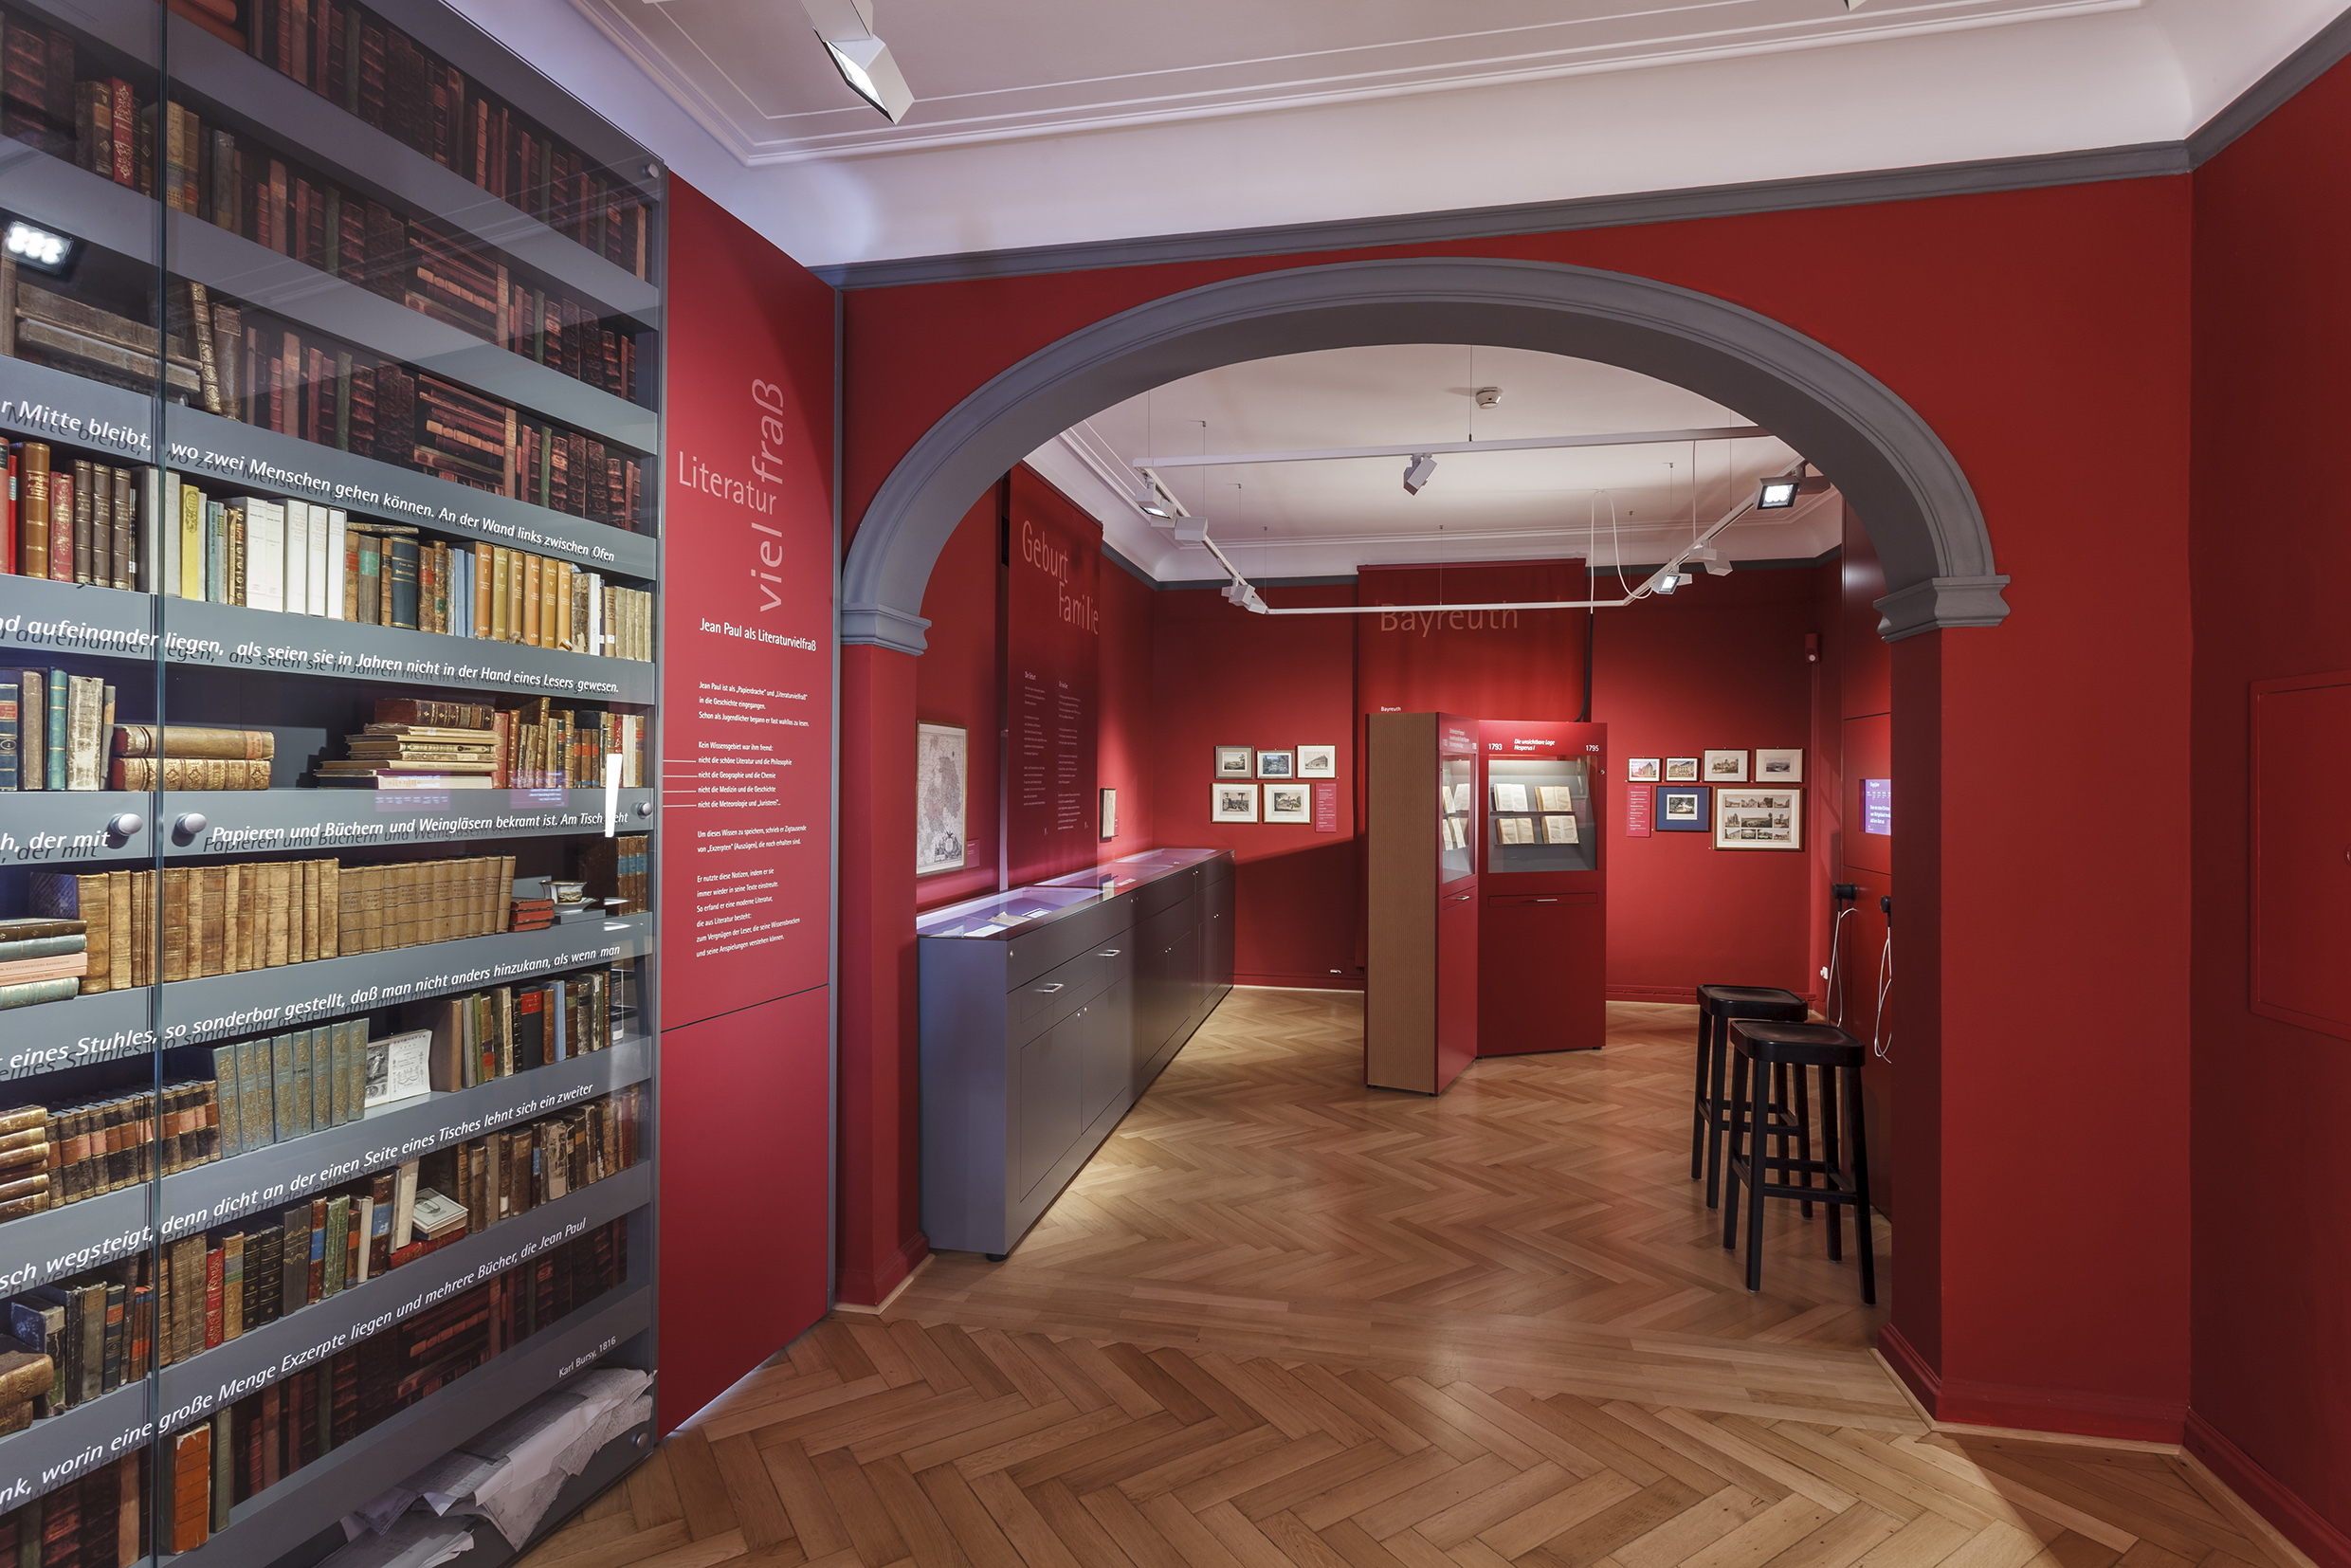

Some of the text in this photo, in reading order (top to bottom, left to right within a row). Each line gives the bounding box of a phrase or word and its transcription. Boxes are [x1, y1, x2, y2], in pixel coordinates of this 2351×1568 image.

[20, 400, 81, 431] Mitte
[89, 418, 151, 451] bleibt,
[171, 442, 199, 459] wo
[204, 447, 245, 470] zwei
[249, 458, 331, 491] Menschen
[335, 483, 379, 503] gehen
[383, 493, 434, 518] können.
[439, 507, 456, 522] An
[460, 513, 479, 528] der
[483, 518, 514, 538] Wand
[518, 526, 542, 544] links
[545, 535, 590, 556] zwischen
[592, 545, 614, 561] Ofen
[679, 451, 776, 515] Literatur
[751, 379, 784, 612] viel fraß
[1023, 520, 1067, 584] Geburt
[700, 618, 816, 651] Jean Paul als Literaturvielfraß
[1059, 581, 1098, 635] Familie
[1380, 600, 1517, 637] Bayreuth
[27, 620, 158, 647] aufeinander
[165, 631, 225, 656] liegen,
[237, 641, 262, 657] als
[267, 646, 308, 662] seien
[313, 649, 334, 665] sie
[338, 651, 352, 665] in
[355, 653, 402, 670] Jahren
[407, 660, 440, 675] nicht
[444, 664, 455, 676] in
[459, 665, 479, 679] der
[481, 666, 511, 682] Hand
[514, 672, 541, 685] eines
[544, 674, 574, 688] Lesers
[577, 680, 619, 692] gewesen.
[713, 698, 738, 706] Geschichte
[710, 741, 741, 751] Wissensgebiet
[28, 831, 67, 848] der
[74, 830, 110, 848] mit
[212, 827, 284, 846] Papieren
[289, 824, 321, 839] und
[325, 823, 384, 837] Büchern
[390, 819, 415, 833] und
[419, 817, 493, 835] Weingläsern
[496, 815, 539, 829] bekramt
[542, 813, 557, 827] ist.
[560, 812, 577, 825] Am
[580, 812, 603, 824] Tisch
[704, 903, 719, 912] erfand
[736, 899, 754, 907] moderne
[9, 945, 620, 1067] eines Stuhles, so sonderbar gestellt, daß man nicht anders hinzukann, als wenn man
[46, 1226, 154, 1273] wegsteigt,
[161, 1208, 207, 1234] denn
[213, 1190, 257, 1215] dicht
[264, 1184, 283, 1199] an
[289, 1171, 317, 1191] der
[320, 1160, 359, 1181] einen
[364, 1146, 398, 1166] Seite
[401, 1136, 434, 1154] eines
[439, 1121, 481, 1141] Tisches
[483, 1110, 513, 1127] lehnt
[516, 1102, 537, 1116] sich
[539, 1096, 555, 1110] ein
[556, 1084, 593, 1103] zweiter
[42, 1442, 102, 1484] worin
[111, 1421, 153, 1451] eine
[158, 1395, 213, 1433] große
[218, 1365, 276, 1402] Menge
[281, 1331, 346, 1373] Exzerpte
[351, 1309, 392, 1340] liegen
[396, 1294, 422, 1318] und
[426, 1272, 475, 1304] mehrere
[478, 1251, 518, 1279] Bücher,
[520, 1242, 537, 1260] die
[538, 1231, 562, 1249] Jean
[565, 1217, 586, 1240] Paul
[559, 1336, 616, 1377] Karl Bursy, 1816
